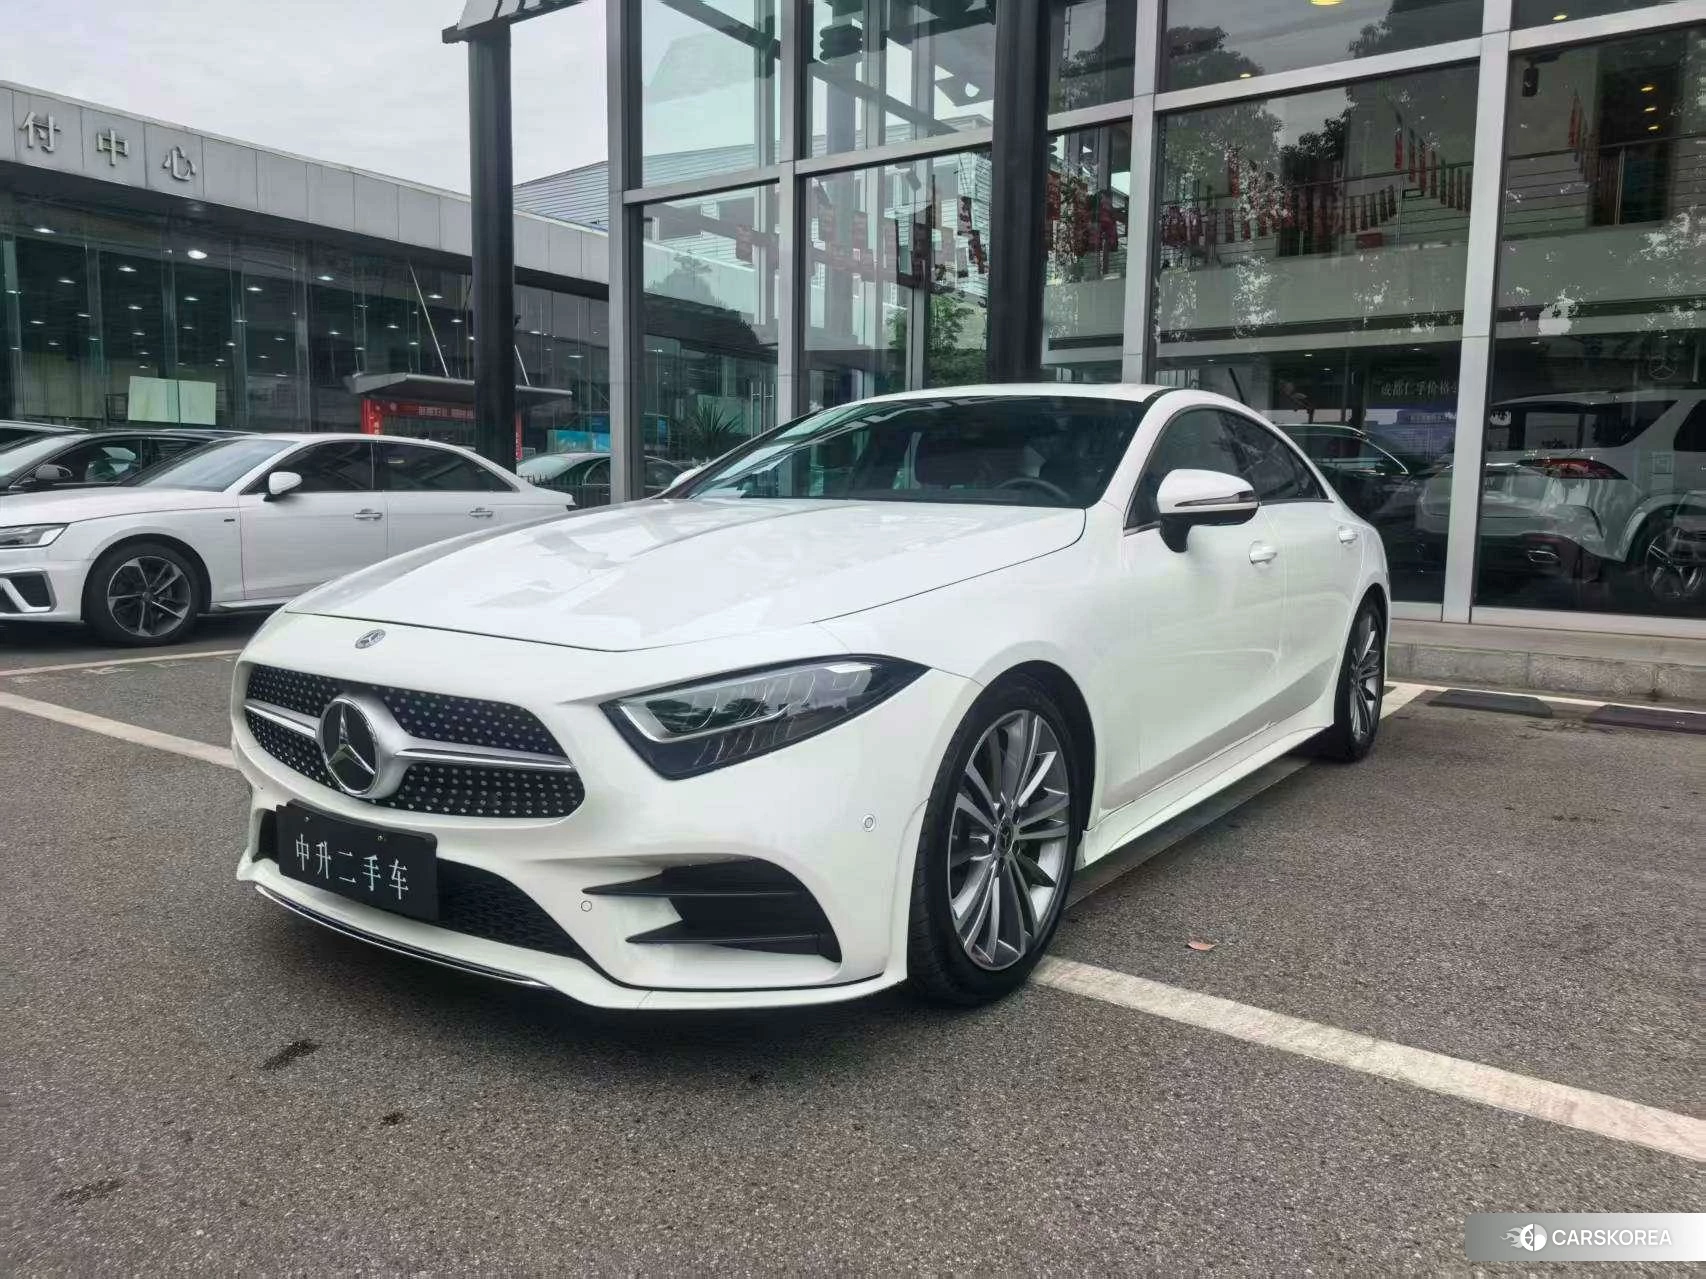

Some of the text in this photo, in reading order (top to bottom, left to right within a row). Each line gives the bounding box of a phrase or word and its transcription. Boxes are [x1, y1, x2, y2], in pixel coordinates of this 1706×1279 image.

[19, 110, 197, 181] 付中心
[295, 832, 409, 901] 中升二手车
